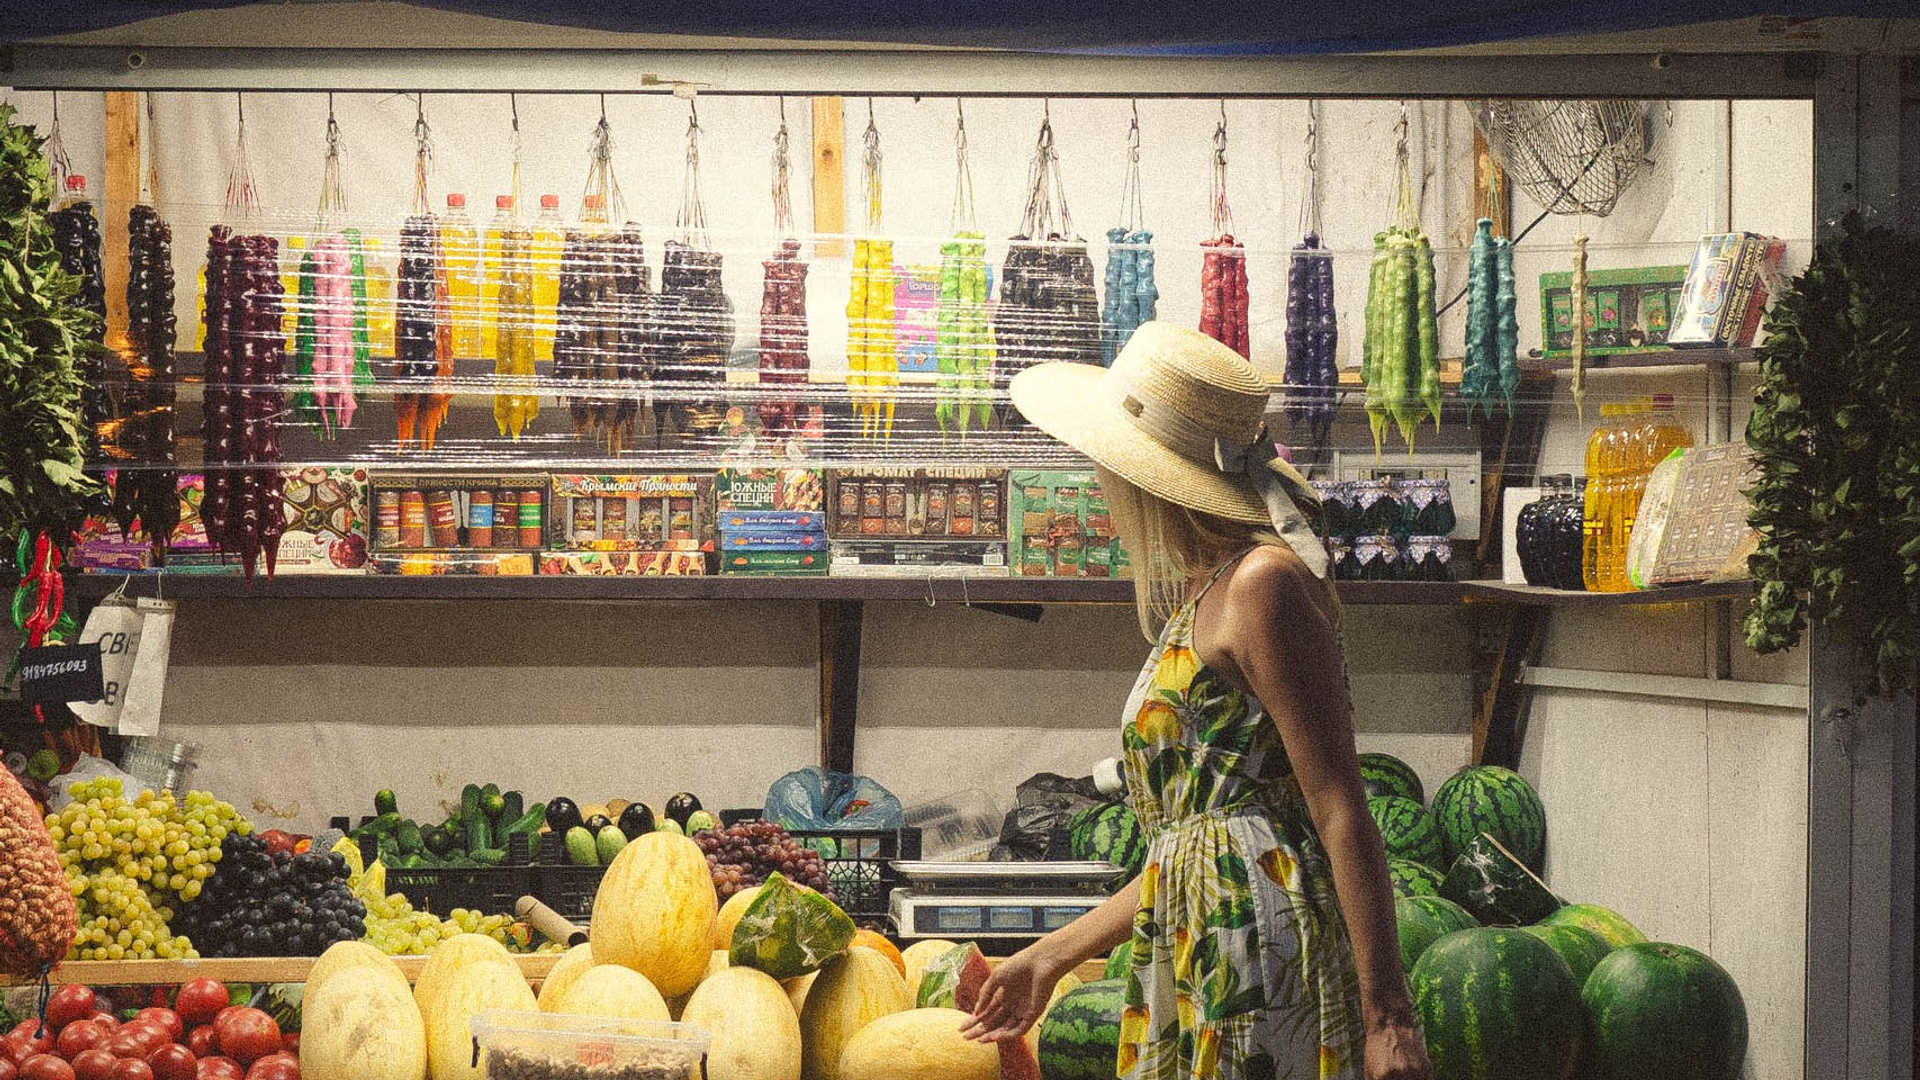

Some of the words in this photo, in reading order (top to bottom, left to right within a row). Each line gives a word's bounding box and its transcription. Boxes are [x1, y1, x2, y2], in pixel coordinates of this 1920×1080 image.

[852, 467, 915, 478] АРОМАТ
[581, 479, 637, 492] Крымские
[640, 479, 697, 492] Пряности
[731, 481, 777, 493] ЮЖНЫЕ
[730, 492, 774, 504] СПЕЦИИ
[22, 659, 87, 681] 9184756093
